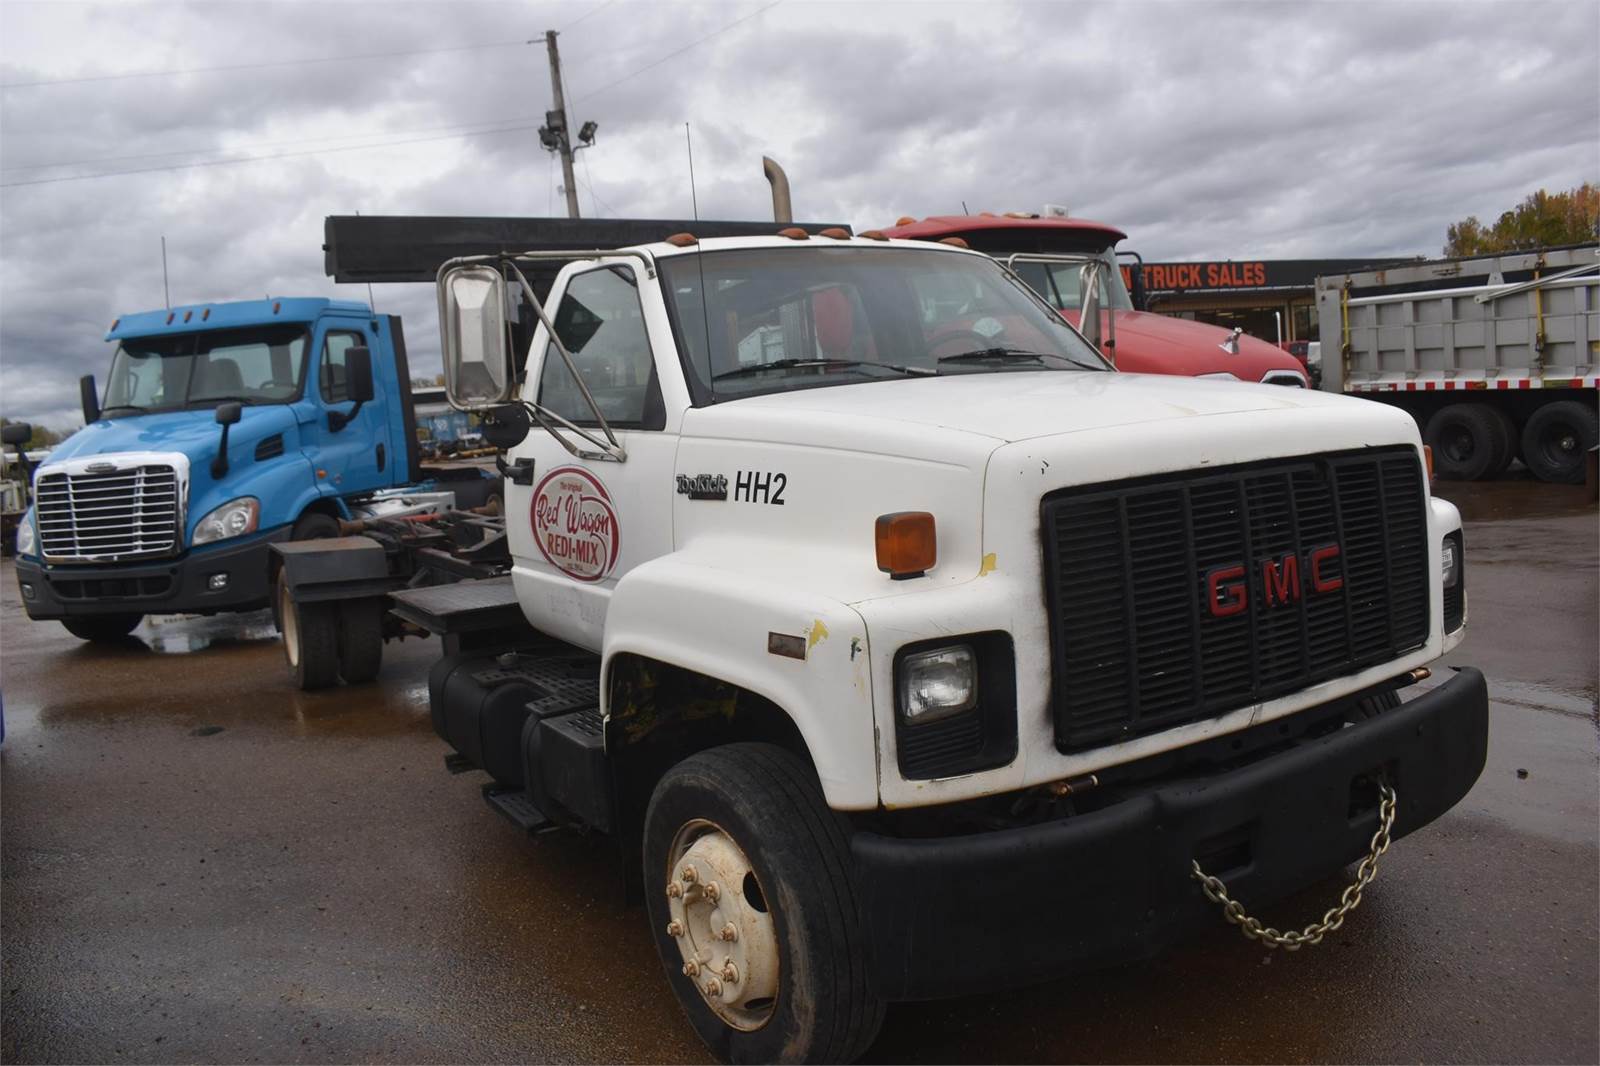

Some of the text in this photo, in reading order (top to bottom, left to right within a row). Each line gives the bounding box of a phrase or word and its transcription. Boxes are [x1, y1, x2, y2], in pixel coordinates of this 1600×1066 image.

[1143, 264, 1202, 289] TRUCK
[1207, 263, 1266, 287] SALES
[735, 470, 787, 505] HH2
[537, 494, 609, 537] Red Wagon
[547, 533, 599, 565] REDI-MIX
[1208, 544, 1344, 617] GMC
